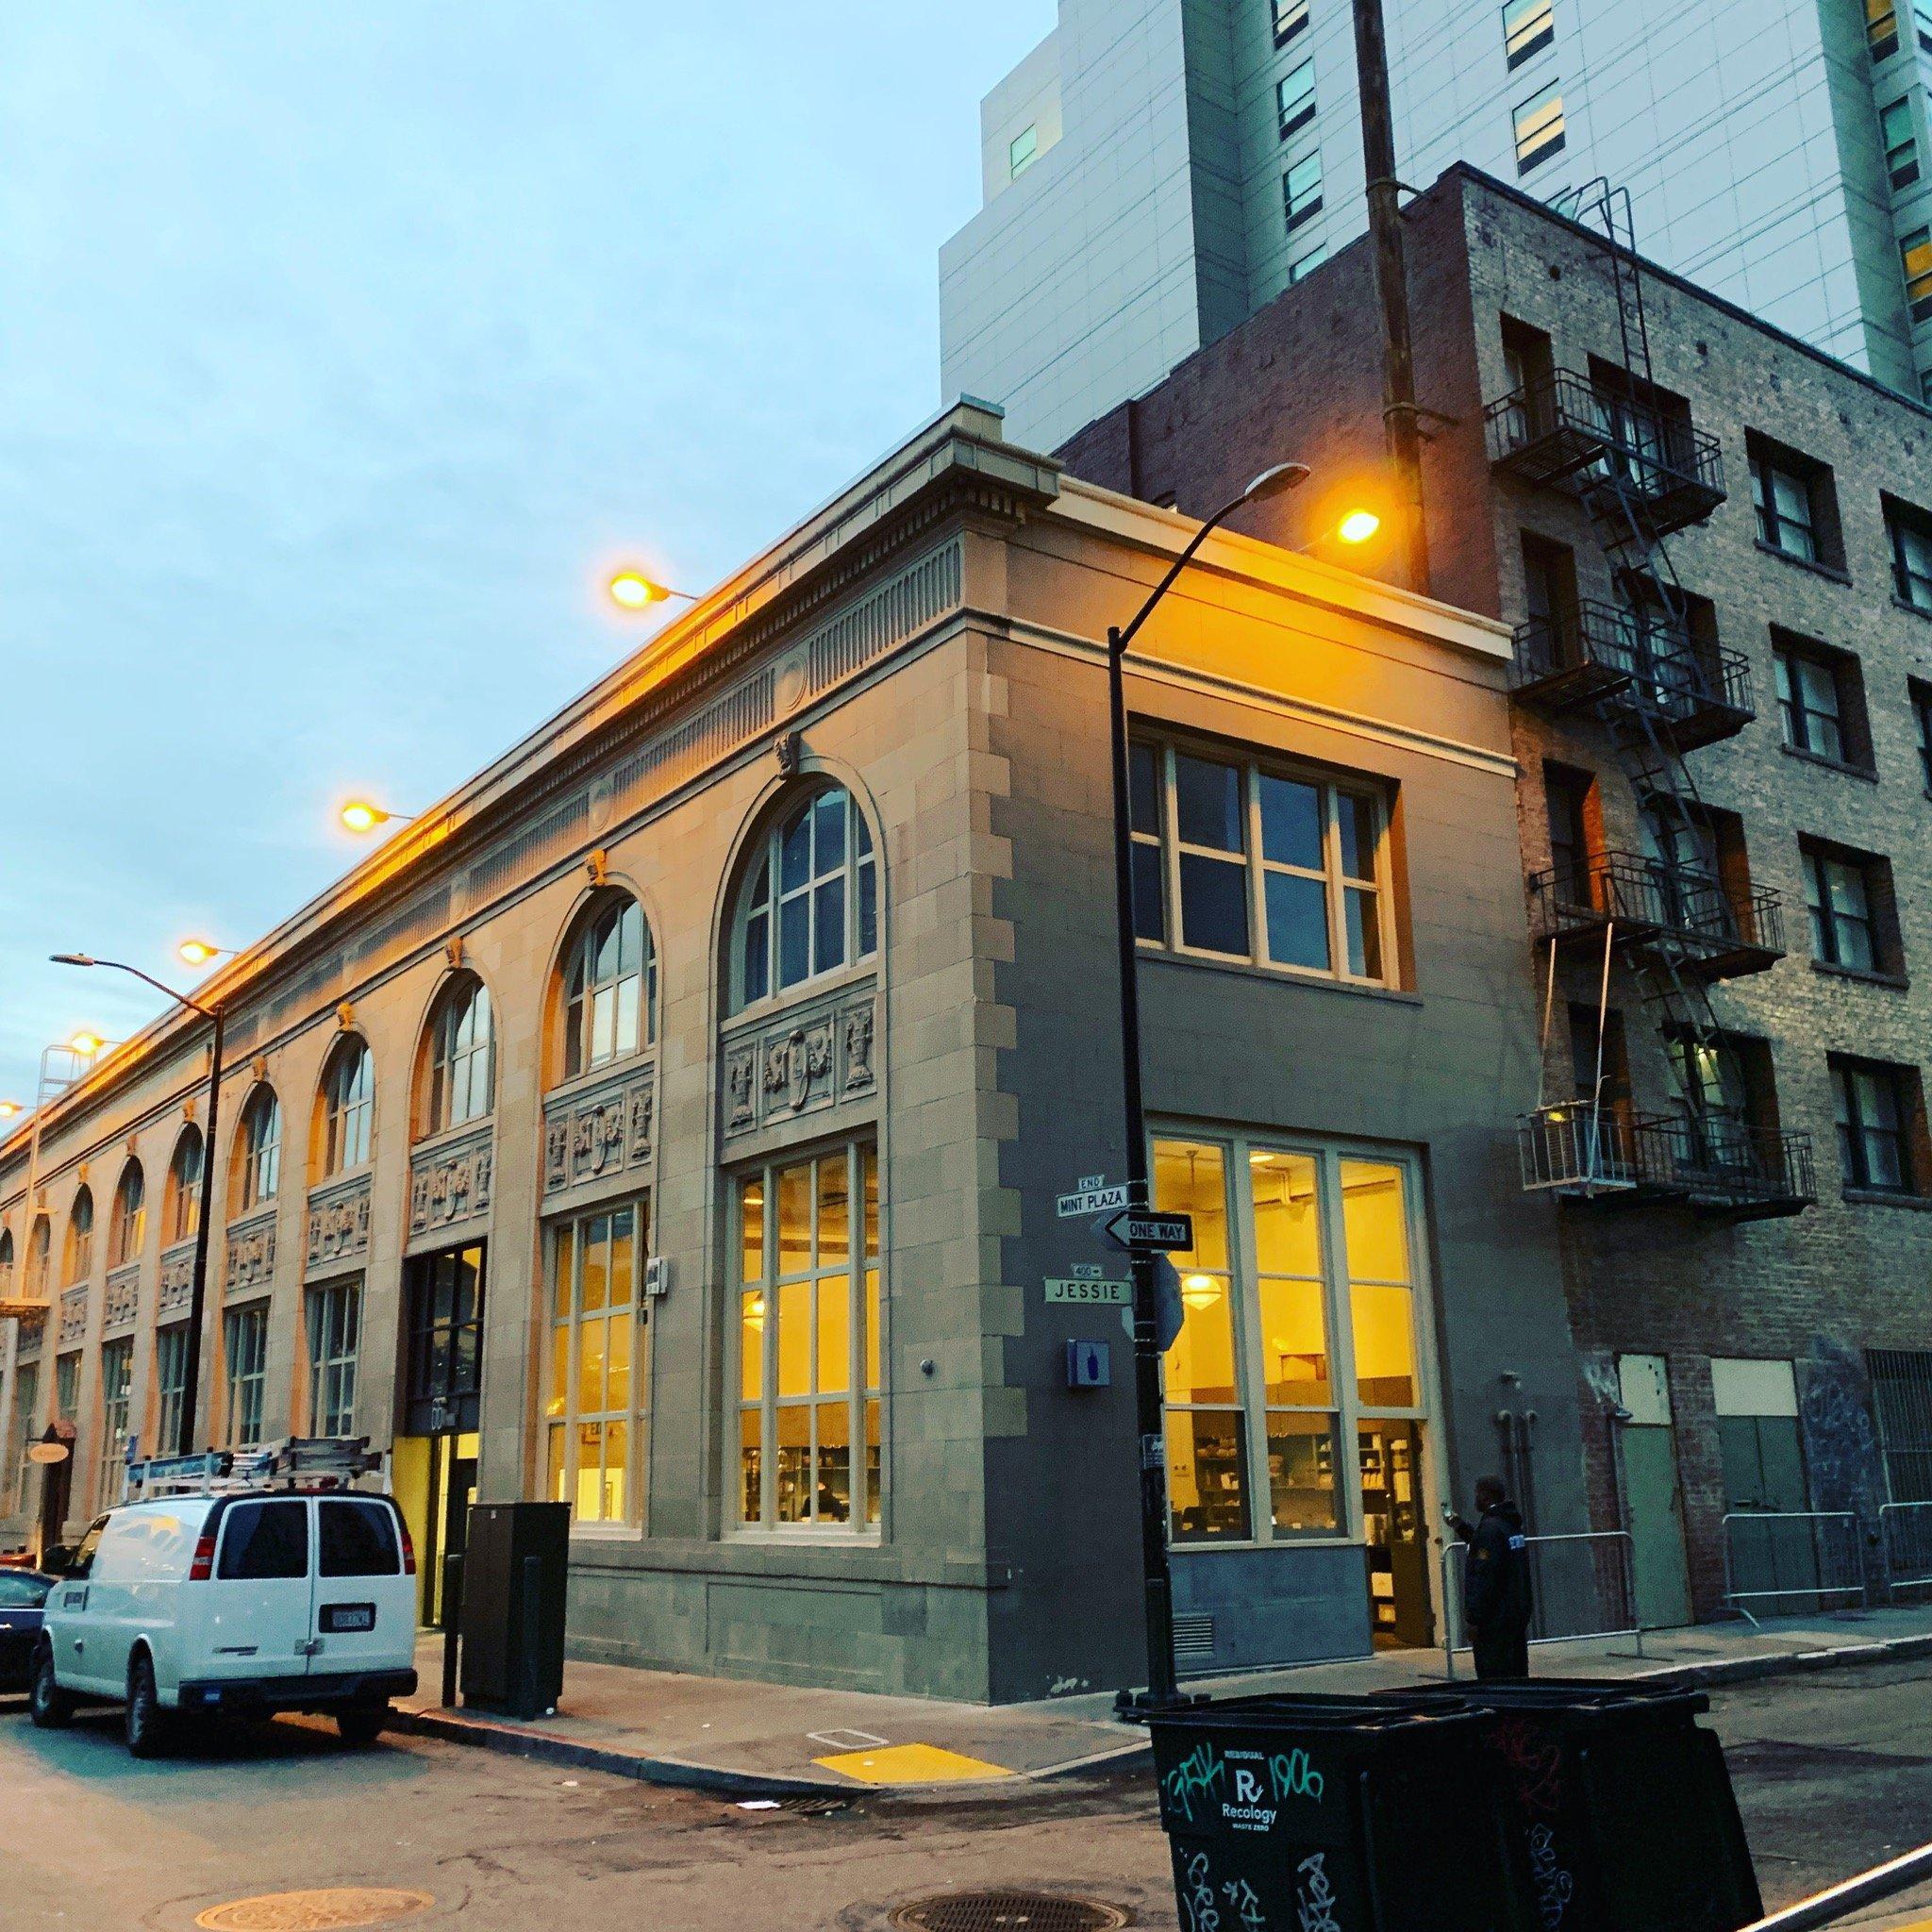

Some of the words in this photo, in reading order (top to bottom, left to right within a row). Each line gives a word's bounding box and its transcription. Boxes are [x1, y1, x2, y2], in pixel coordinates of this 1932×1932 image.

[1081, 1177, 1100, 1189] END
[1060, 1197, 1082, 1213] MINT
[1088, 1191, 1124, 1209] PLAZA
[1130, 1223, 1155, 1238] ONE
[1159, 1224, 1184, 1240] WAY
[1055, 1282, 1121, 1300] JESSIE
[1222, 1803, 1277, 1824] Recology
[1232, 1823, 1252, 1831] WASTE
[1253, 1824, 1270, 1832] ZERO
